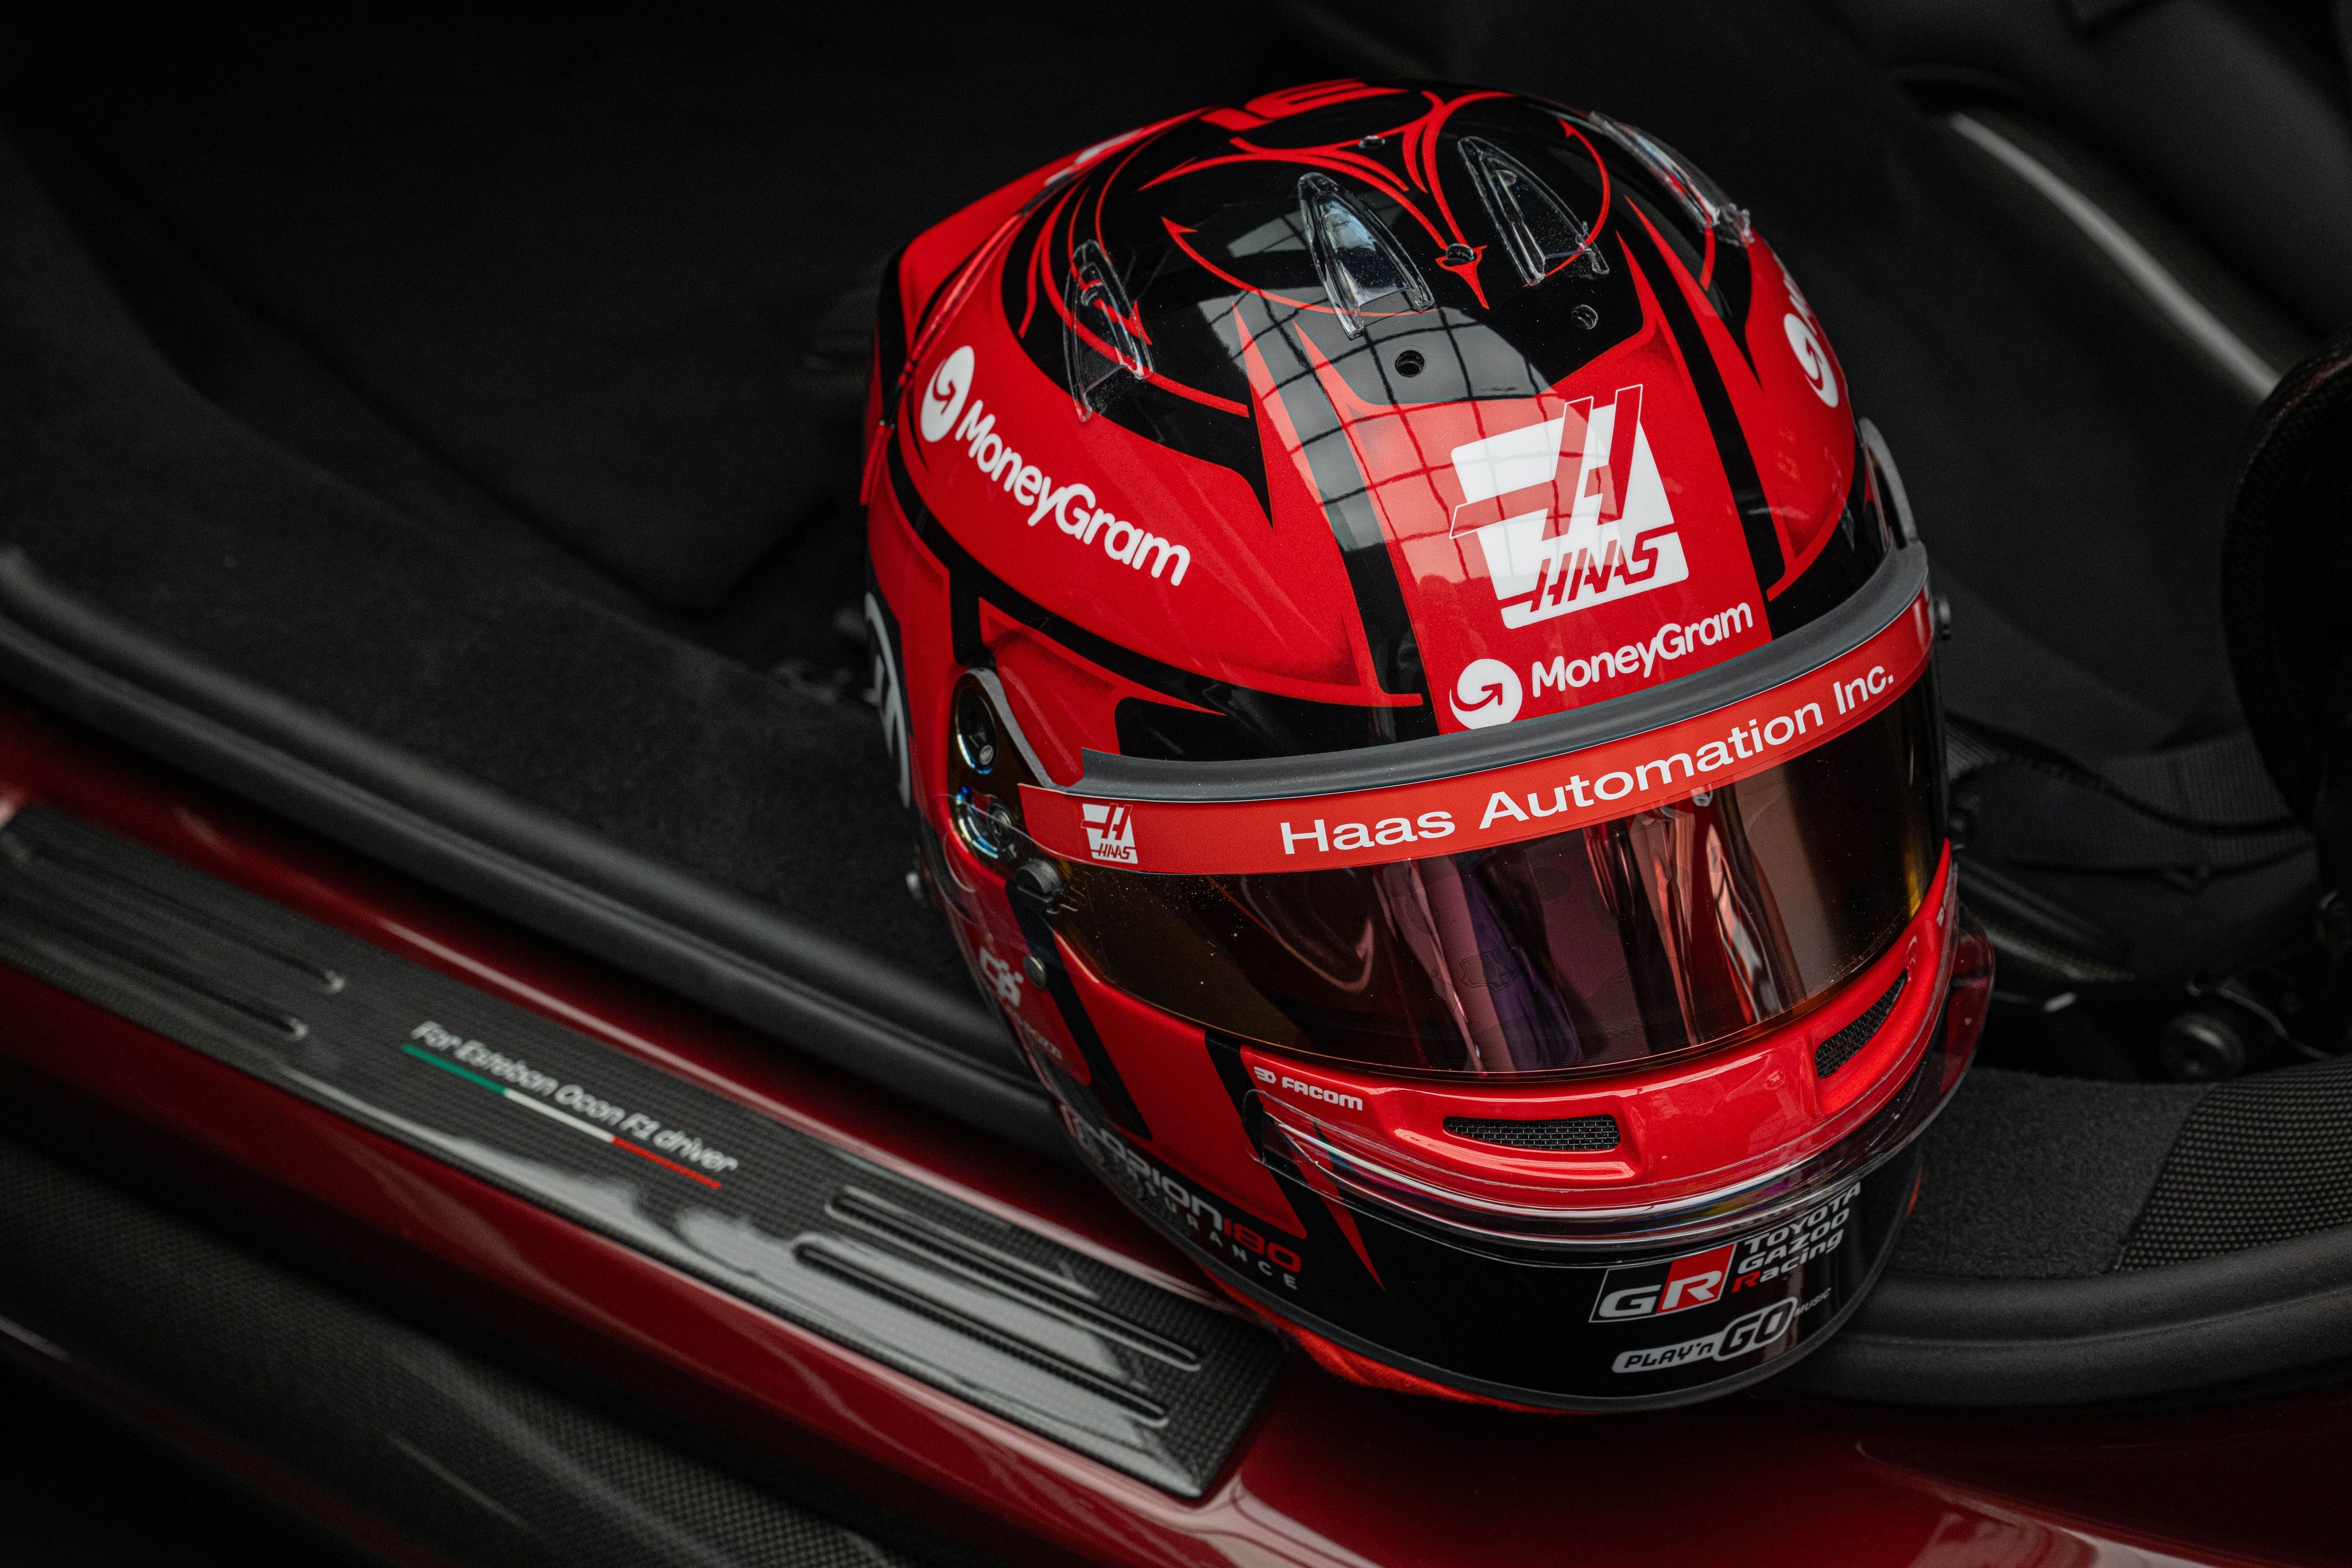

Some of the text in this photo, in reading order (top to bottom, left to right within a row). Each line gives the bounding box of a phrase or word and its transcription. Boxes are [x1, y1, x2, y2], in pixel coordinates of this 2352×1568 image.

[955, 399, 1191, 586] MoneyGram
[1506, 529, 1670, 613] HAAS
[1532, 602, 1754, 697] MoneyGram
[1281, 665, 1894, 854] Haas Automation Inc.
[1094, 843, 1134, 860] HAAS
[410, 1020, 462, 1051] For
[454, 1040, 559, 1097] Esteban
[555, 1084, 626, 1126] Ocon
[653, 1130, 739, 1172] driver
[1282, 1077, 1363, 1111] FACOM
[1737, 1207, 1850, 1275] GAZOO
[1743, 1181, 1861, 1255] TOYOTA
[1599, 1269, 1723, 1318] GR
[1731, 1229, 1844, 1294] Racing
[1624, 1341, 1714, 1369] PLAY'n
[1717, 1299, 1795, 1358] GO
